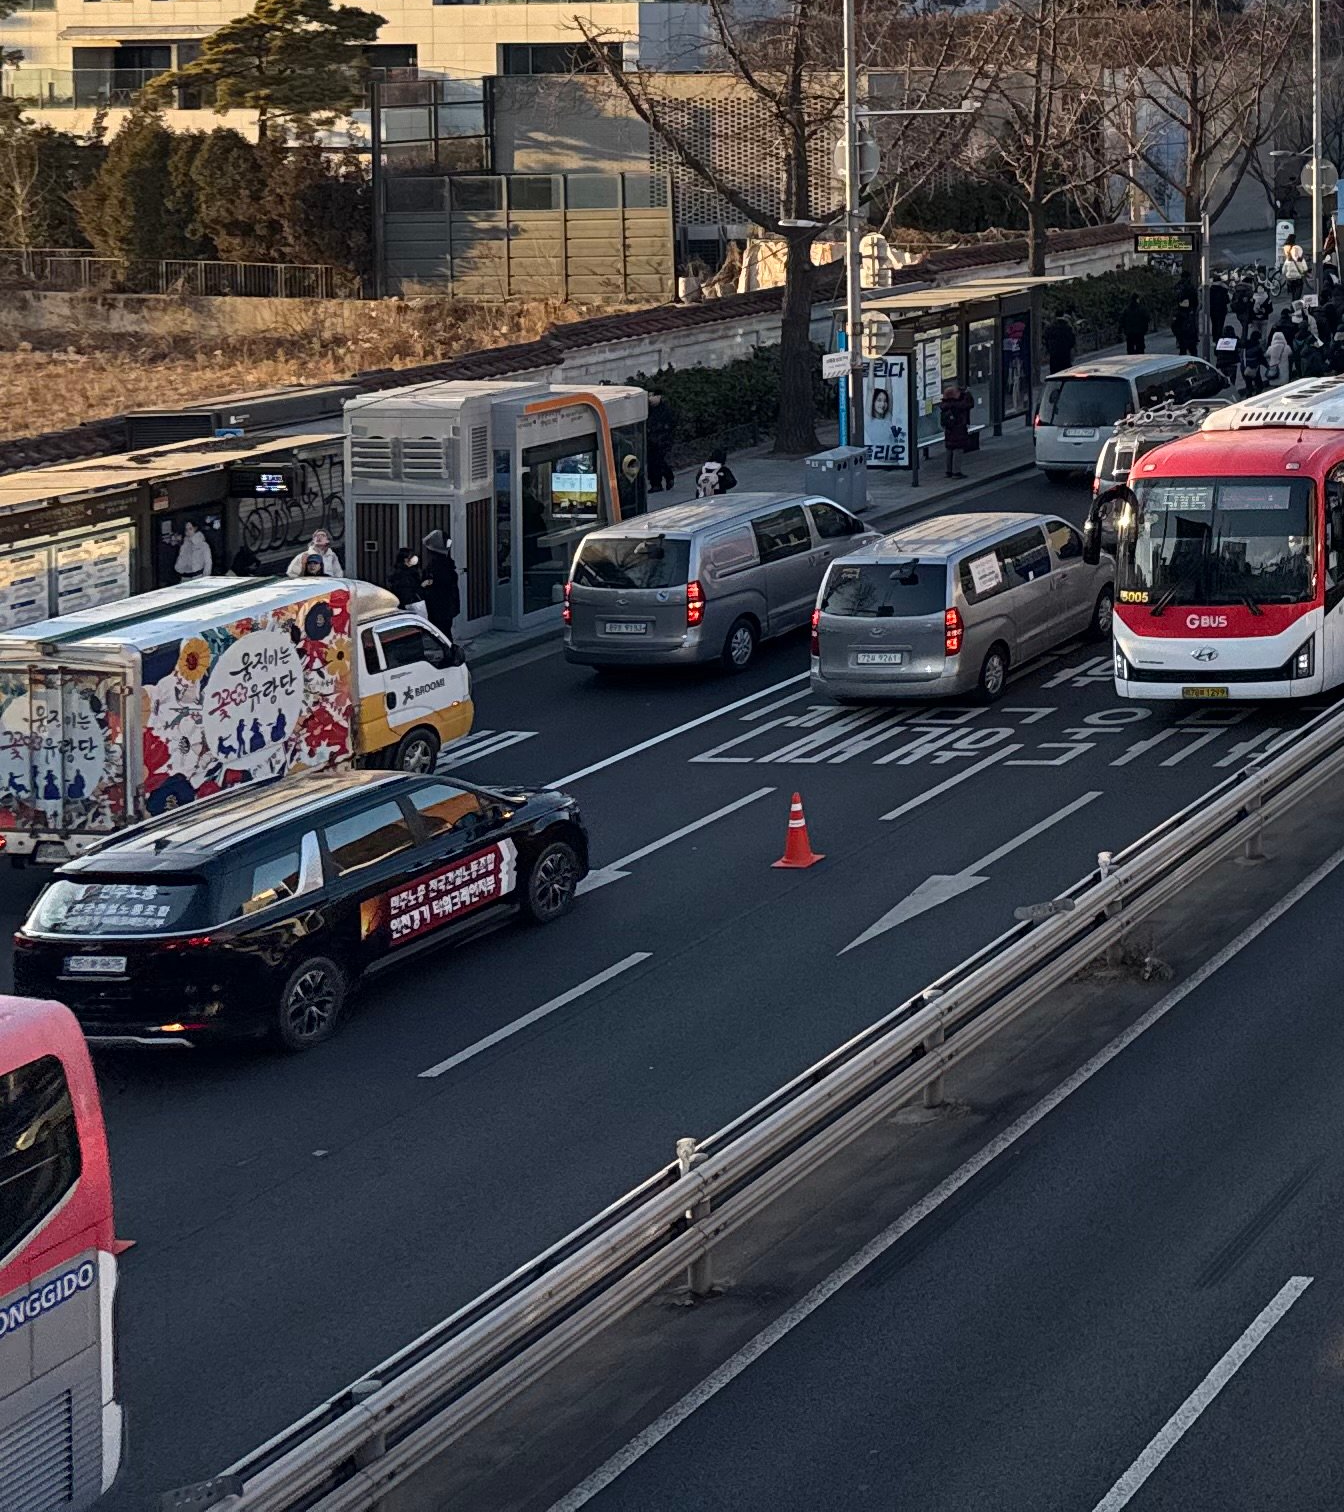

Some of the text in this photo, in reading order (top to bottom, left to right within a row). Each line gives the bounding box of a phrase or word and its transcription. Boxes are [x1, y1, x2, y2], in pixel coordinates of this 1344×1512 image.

[1120, 590, 1149, 603] 5005
[230, 647, 292, 679] 움직이는
[24, 706, 91, 733] 움직이는
[390, 884, 426, 915] 민주노총
